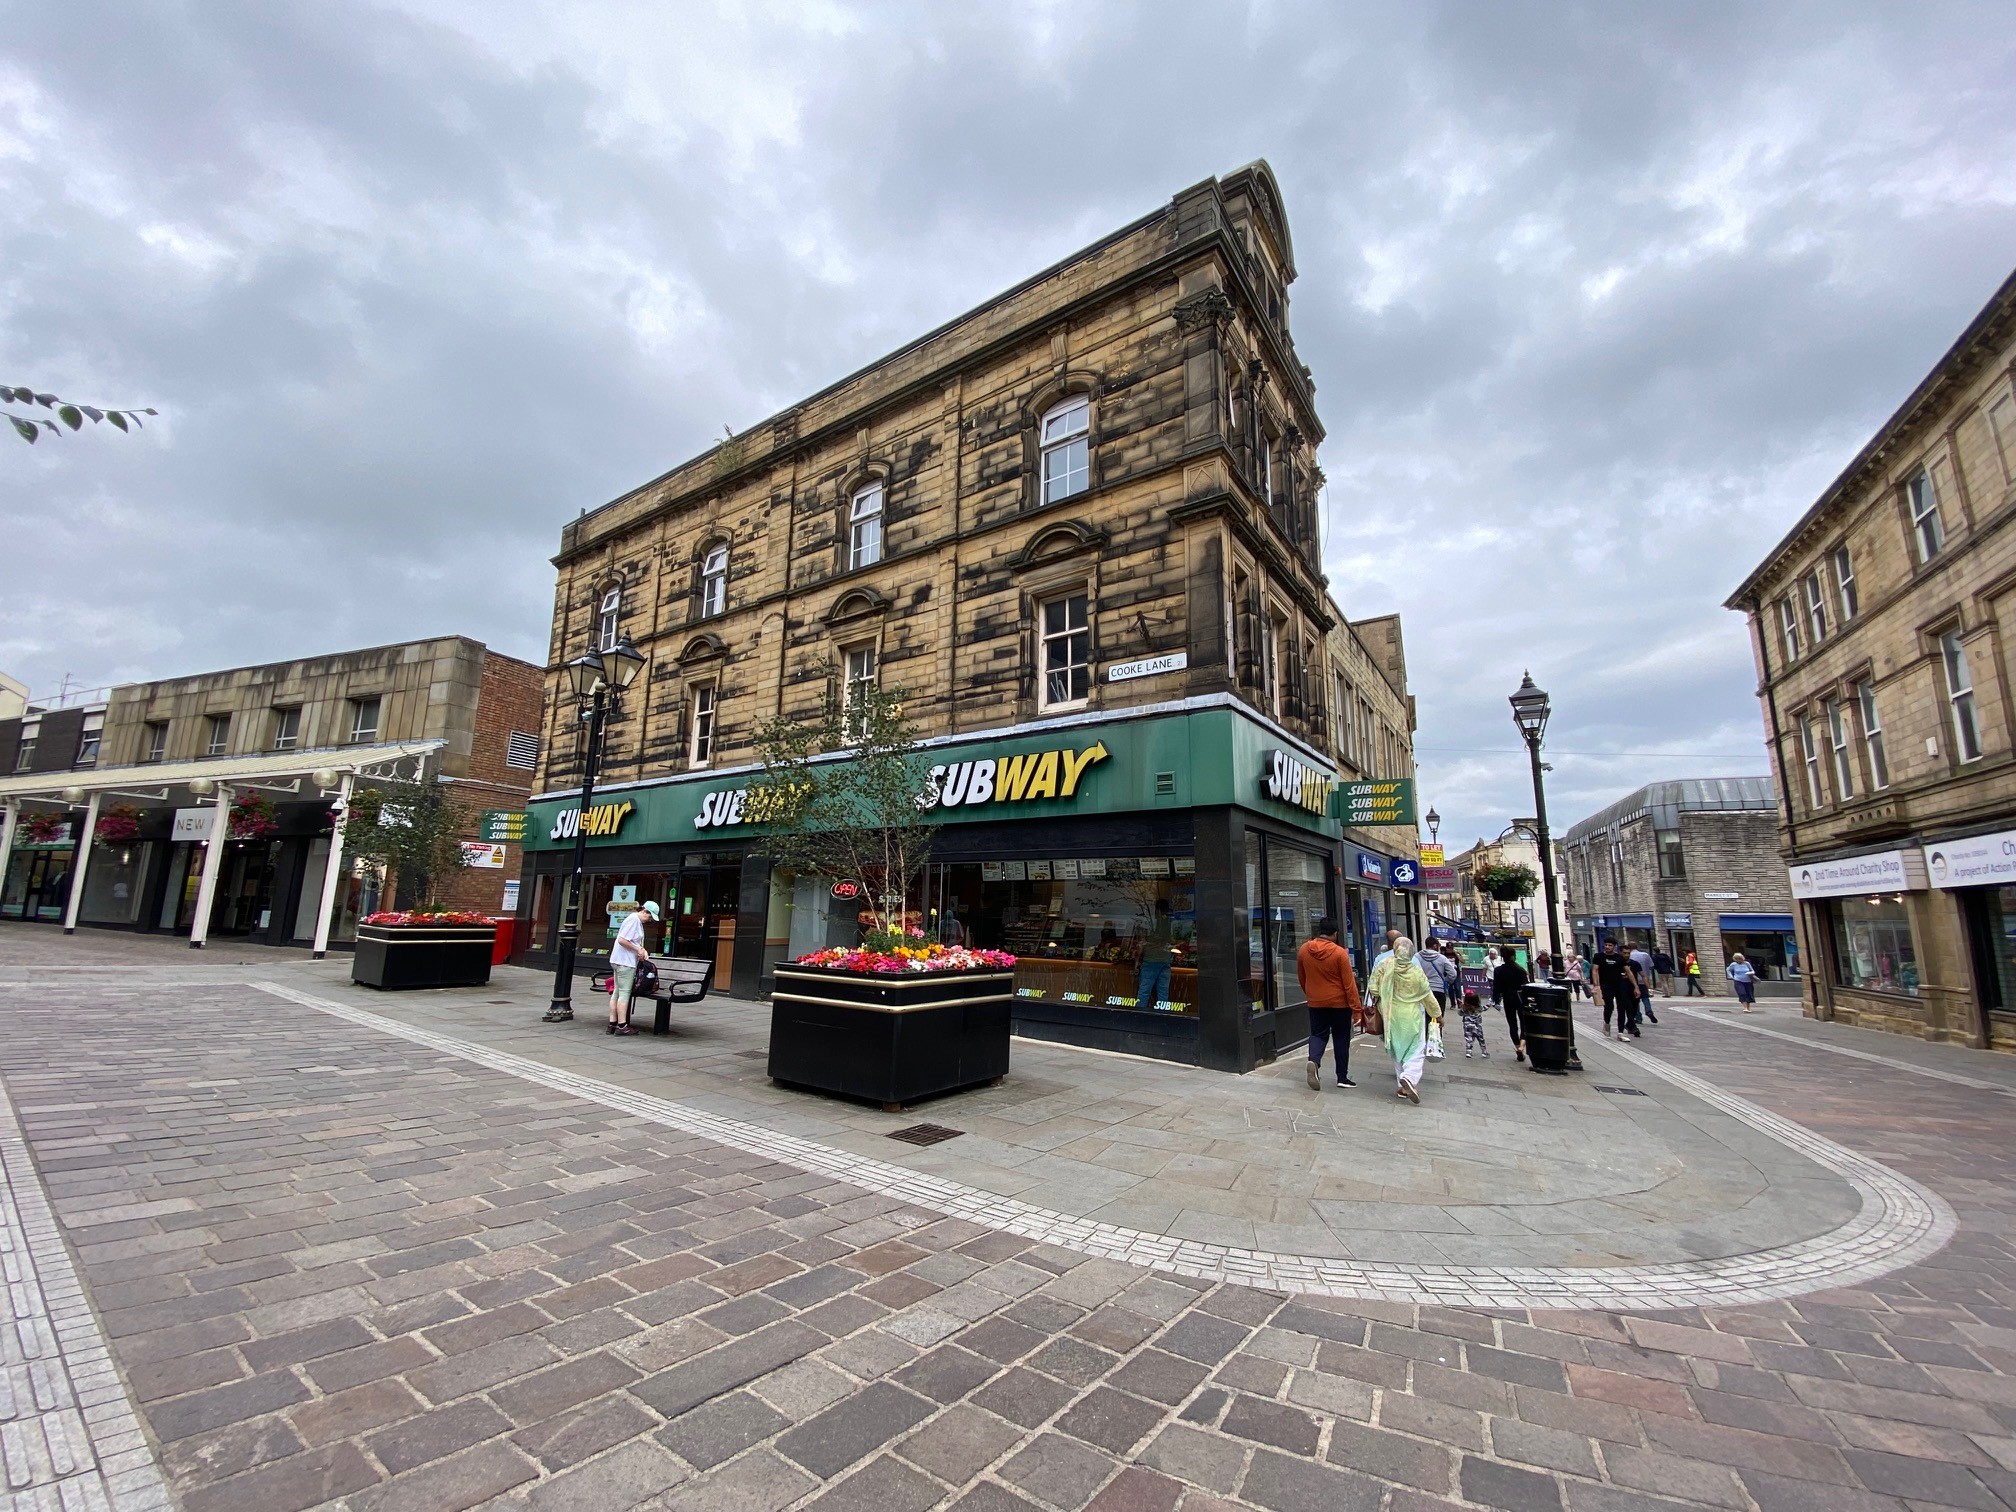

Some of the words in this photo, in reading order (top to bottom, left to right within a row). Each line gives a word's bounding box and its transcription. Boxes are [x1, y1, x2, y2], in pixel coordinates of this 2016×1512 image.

[1111, 664, 1142, 677] COOKE
[1146, 658, 1172, 671] LANE
[914, 741, 1109, 810] SUBWAY
[1269, 749, 1333, 817] SUBWAY
[1347, 783, 1401, 796] SUBWAY
[1348, 796, 1402, 809] SUBWAY
[1349, 810, 1403, 822] SUBWAY
[177, 819, 205, 831] NEW
[490, 822, 527, 830] SUBWAY
[1815, 871, 1825, 880] 2nd
[1825, 868, 1839, 879] Time
[1839, 865, 1860, 878] Around
[1860, 861, 1882, 875] Charity
[1882, 859, 1900, 873] Shop
[1960, 866, 1981, 878] project
[1983, 863, 1989, 874] of
[1991, 862, 2012, 873] Action
[834, 883, 858, 896] OPEN
[1016, 988, 1047, 998] SUBWAY
[1062, 992, 1094, 1003] SUBWAY
[1106, 995, 1140, 1007] SUBWAY
